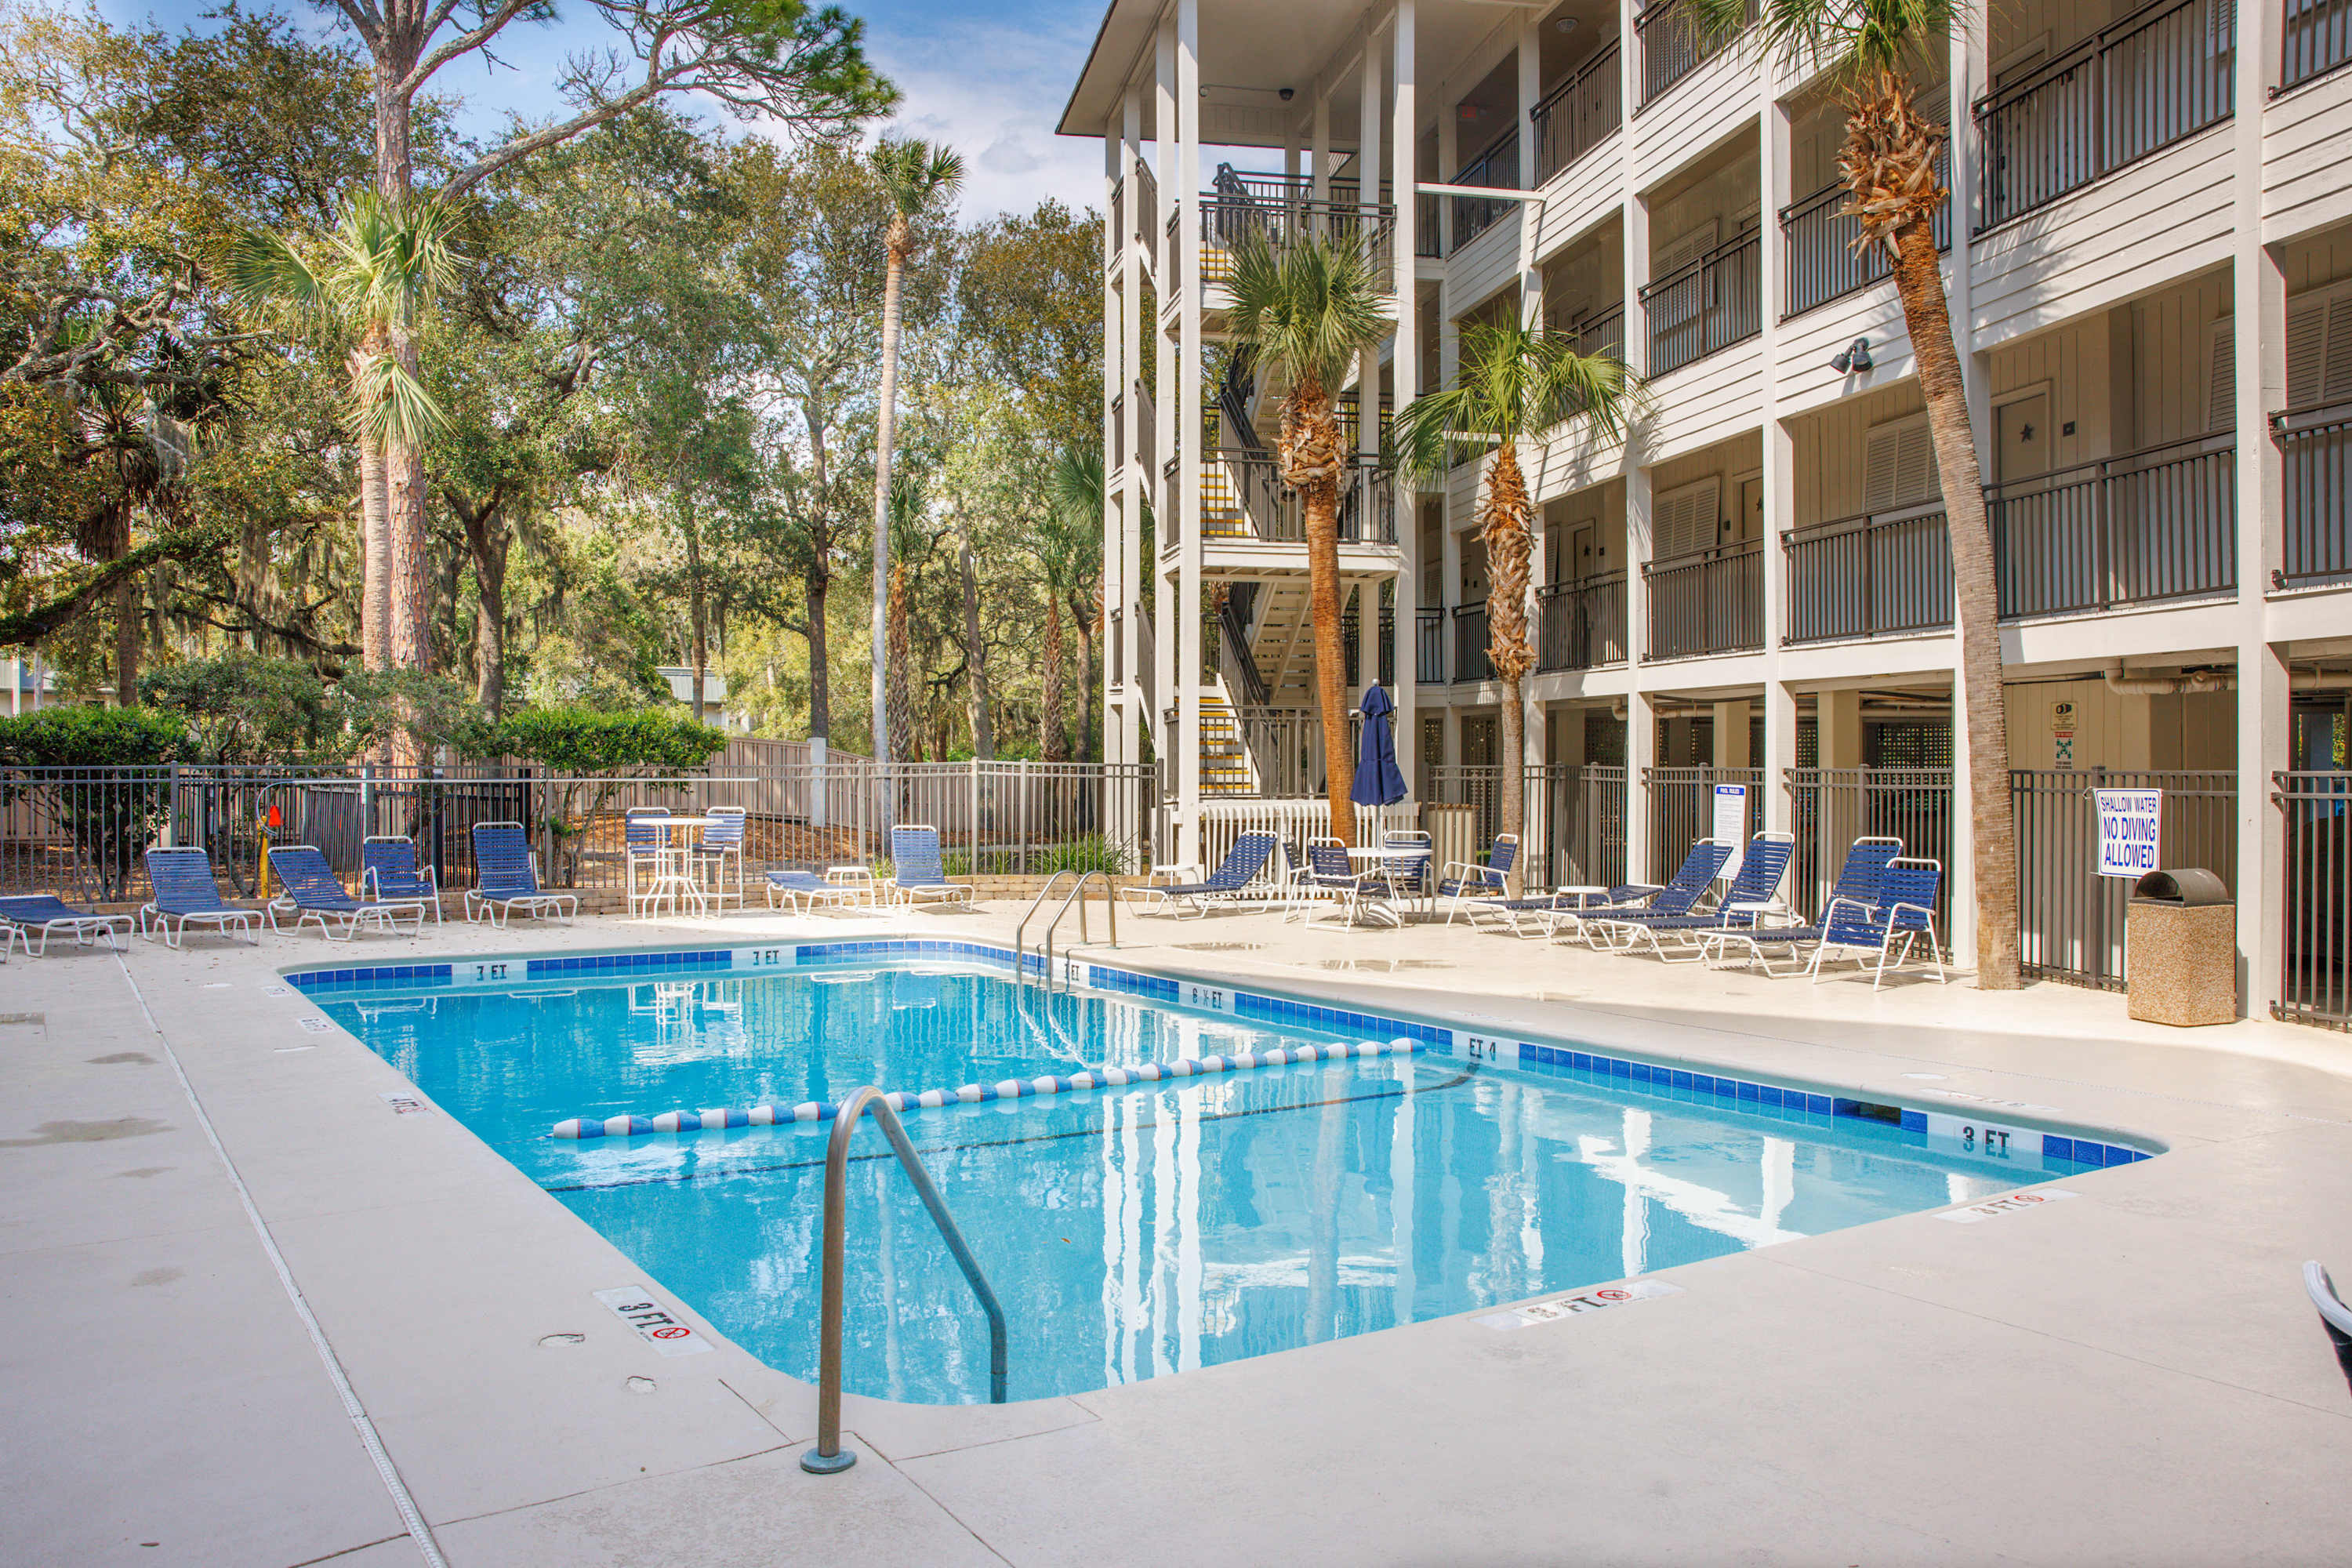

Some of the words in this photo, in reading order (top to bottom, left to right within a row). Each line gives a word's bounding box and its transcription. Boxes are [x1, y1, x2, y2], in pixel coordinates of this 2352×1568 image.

[2101, 797, 2132, 812] SHALLOW
[2134, 797, 2157, 813] WATER
[2103, 816, 2118, 840] NO
[2122, 817, 2156, 841] DIVING
[2104, 843, 2154, 868] ALLOWED
[1962, 1126, 1975, 1148] 3
[1984, 1129, 2010, 1154] FT
[618, 1302, 654, 1312] 3
